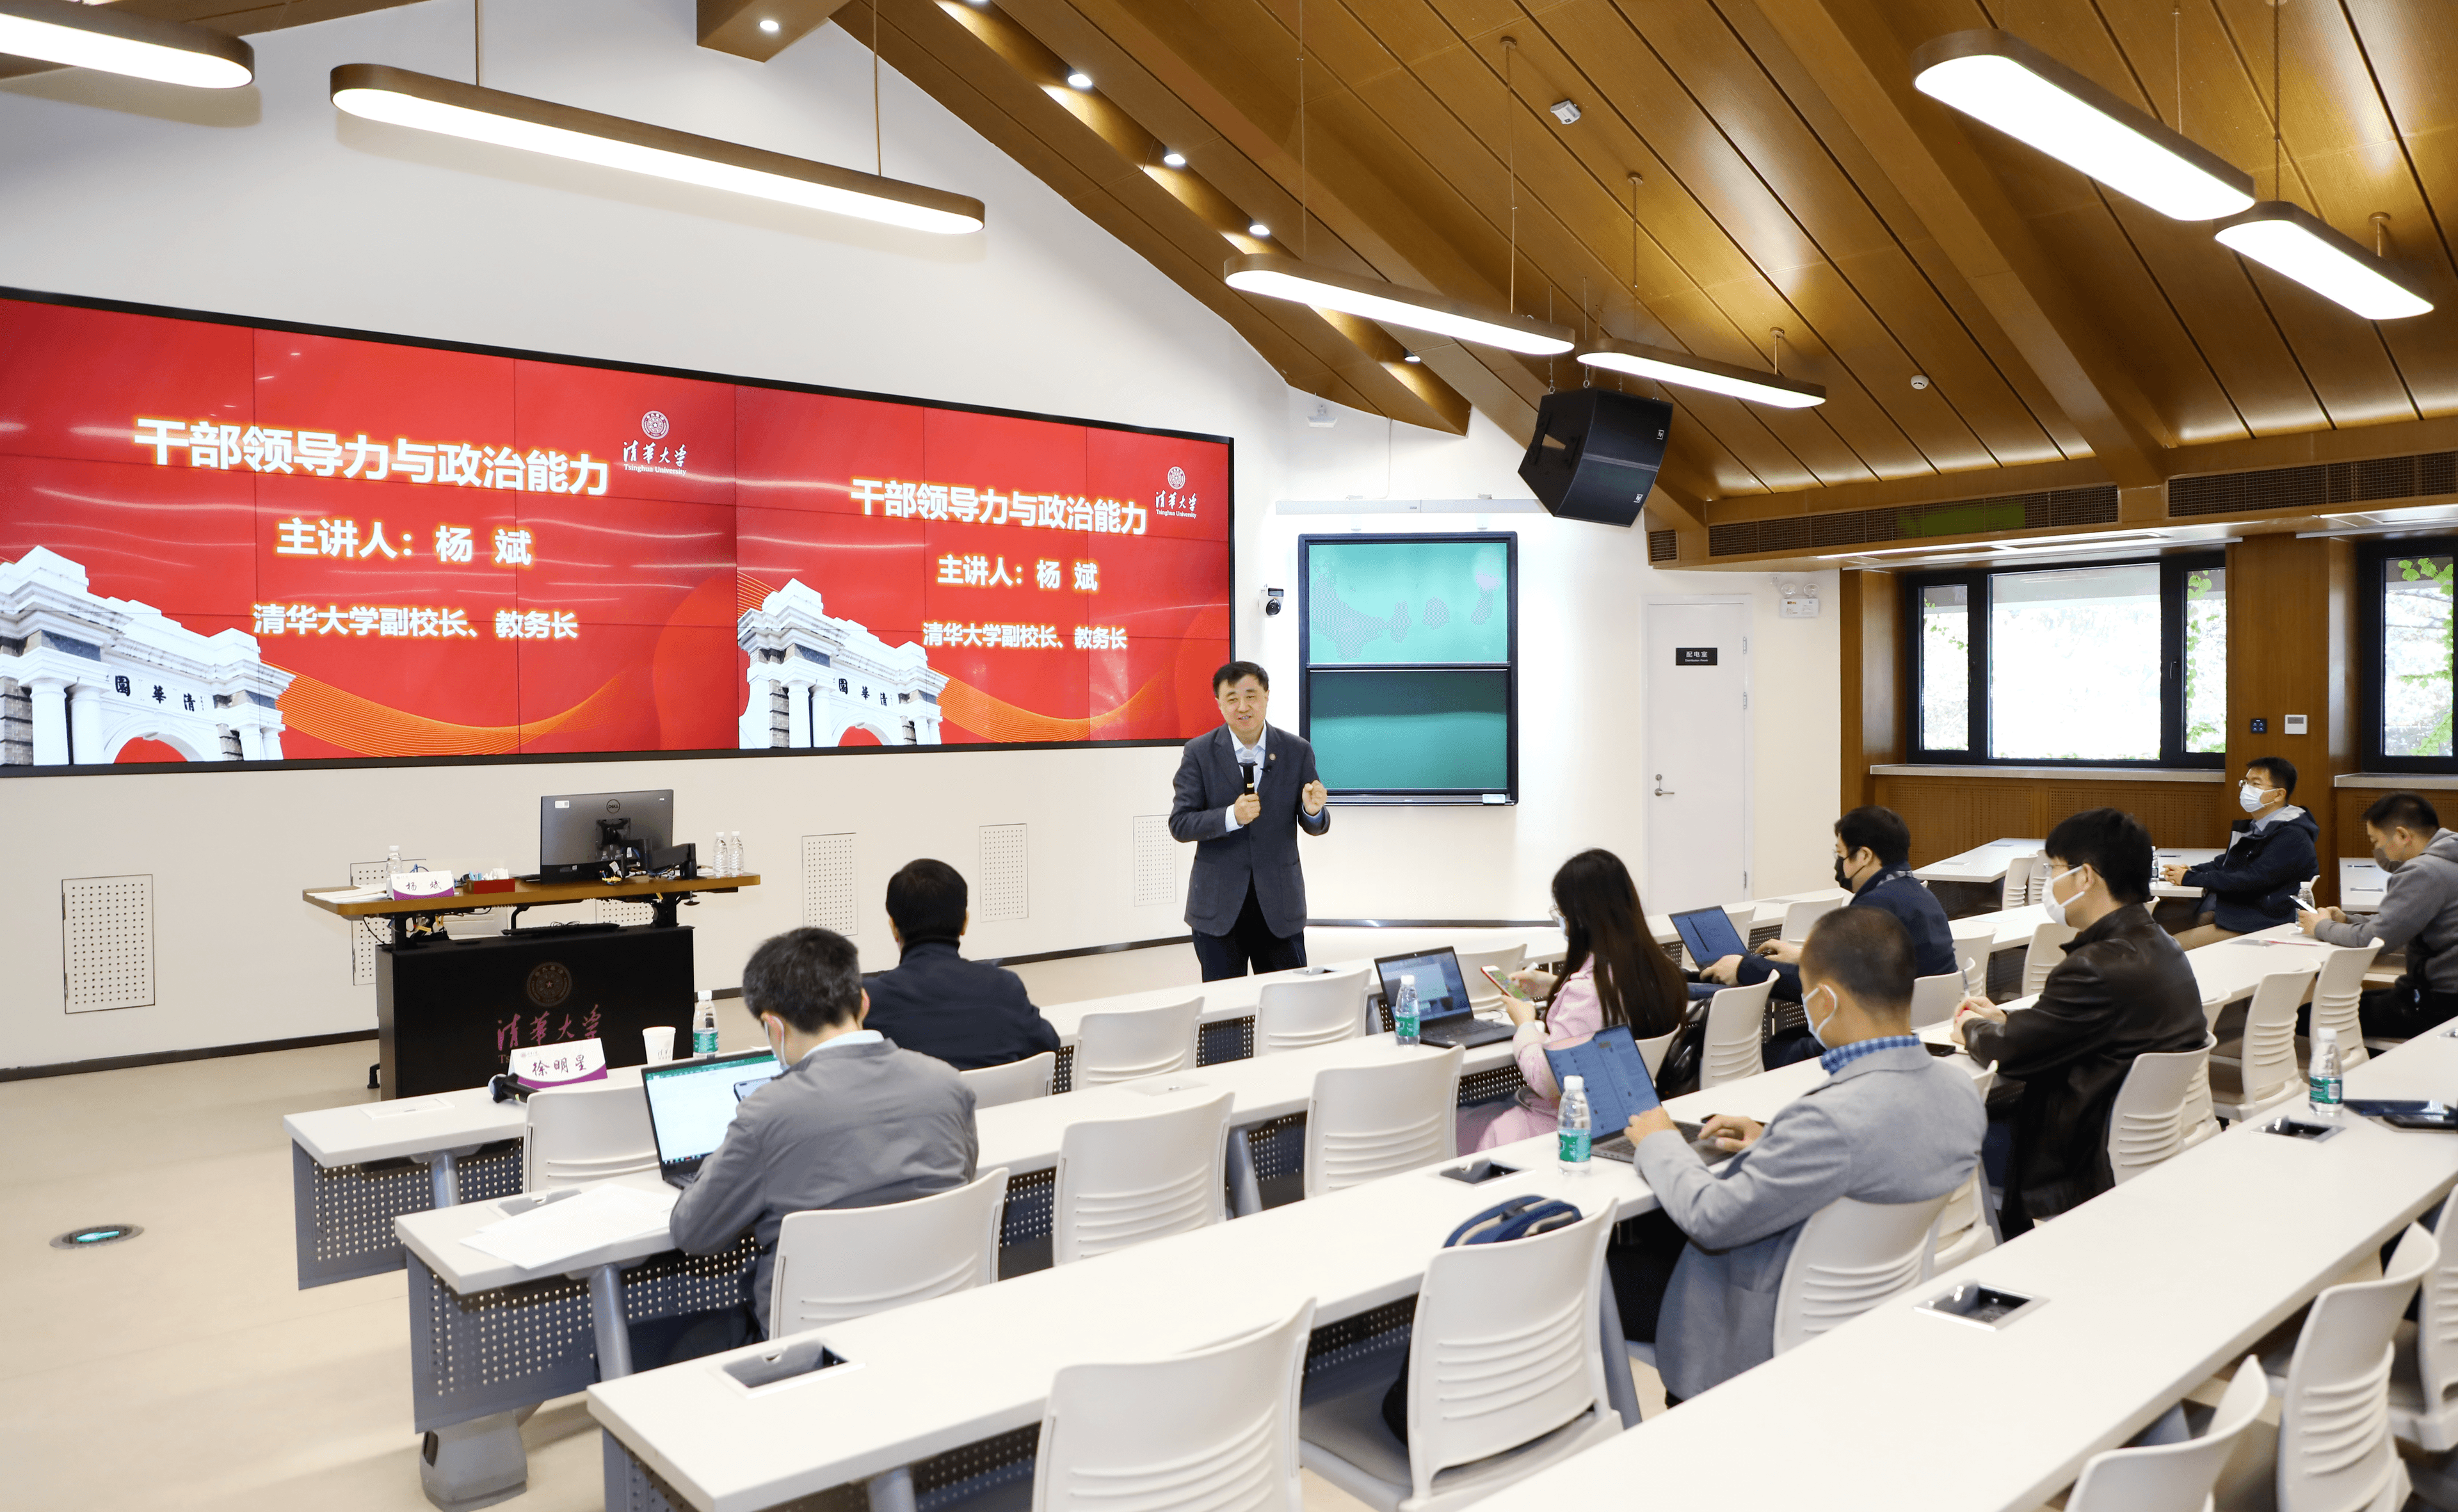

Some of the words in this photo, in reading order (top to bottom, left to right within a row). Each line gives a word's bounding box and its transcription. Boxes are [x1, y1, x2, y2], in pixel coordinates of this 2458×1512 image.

[134, 418, 608, 495] 干部领导力与政治能力
[623, 463, 653, 472] Tsinghua
[655, 466, 687, 476] University
[851, 479, 1147, 535] 干部领导力与政治能力
[1176, 511, 1196, 519] University
[253, 604, 579, 639] 清华大学副校长、教务长
[923, 622, 1127, 650] 清华大学副校长、教务长
[533, 1054, 587, 1077] 徐明星
